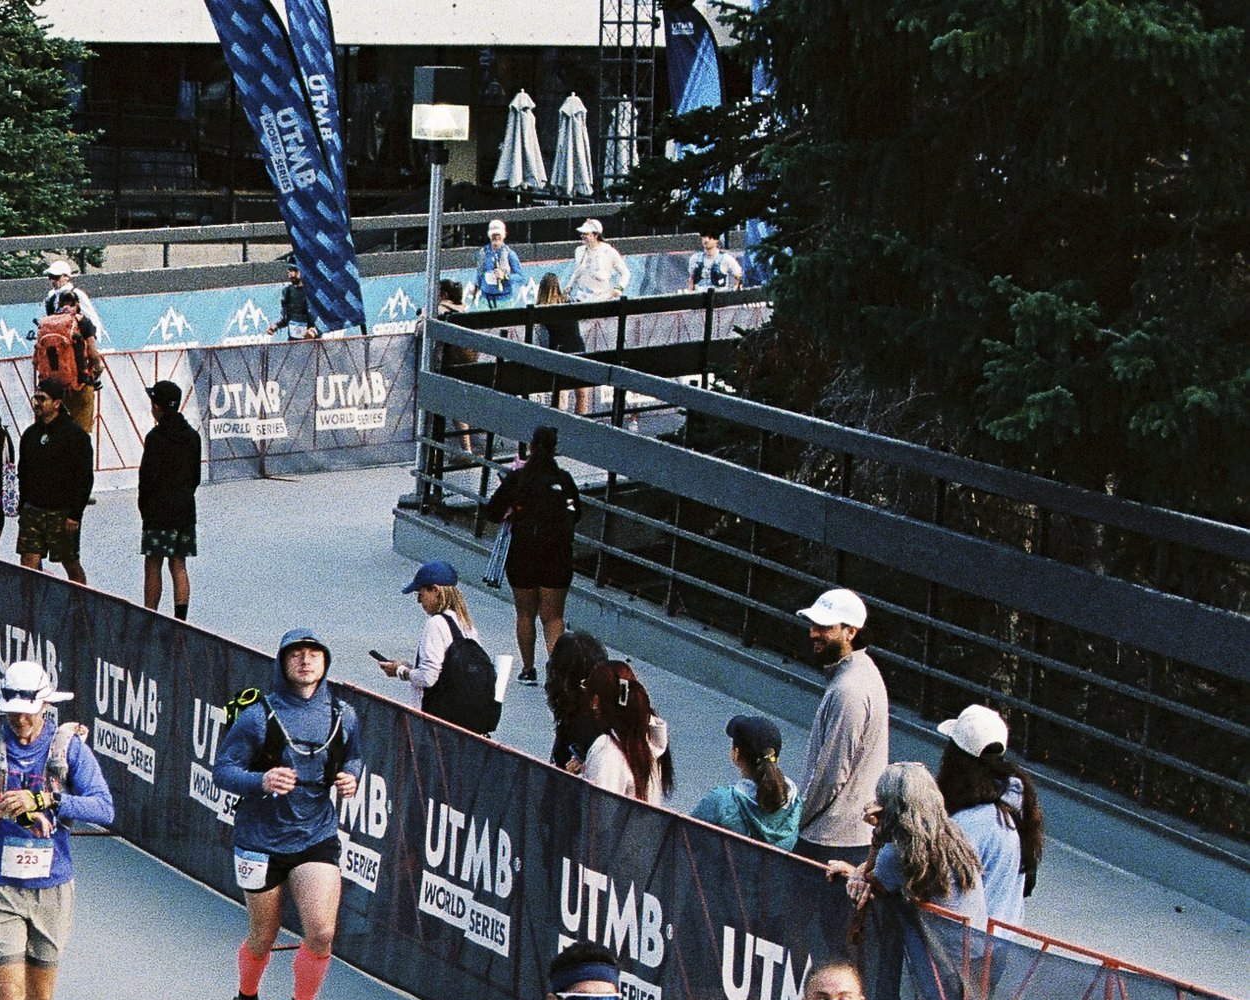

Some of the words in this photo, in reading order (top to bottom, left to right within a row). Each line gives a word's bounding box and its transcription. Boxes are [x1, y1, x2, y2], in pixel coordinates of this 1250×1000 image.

[309, 74, 333, 140] UTMB
[276, 107, 317, 188] UTMB
[274, 158, 291, 191] SERIES
[210, 379, 281, 417] UTMB
[316, 372, 387, 408] UTMB
[212, 422, 251, 433] WORLD
[256, 422, 285, 435] SERIES
[320, 412, 355, 426] WORLD
[357, 412, 384, 425] SERIES
[95, 657, 159, 737] UTMB
[193, 697, 228, 766] UT
[131, 745, 153, 776] SERIES
[330, 764, 388, 839] MB
[16, 854, 39, 865] 223
[346, 849, 378, 883] SERIES
[424, 880, 466, 920] WORLD
[468, 911, 506, 947] SERIES
